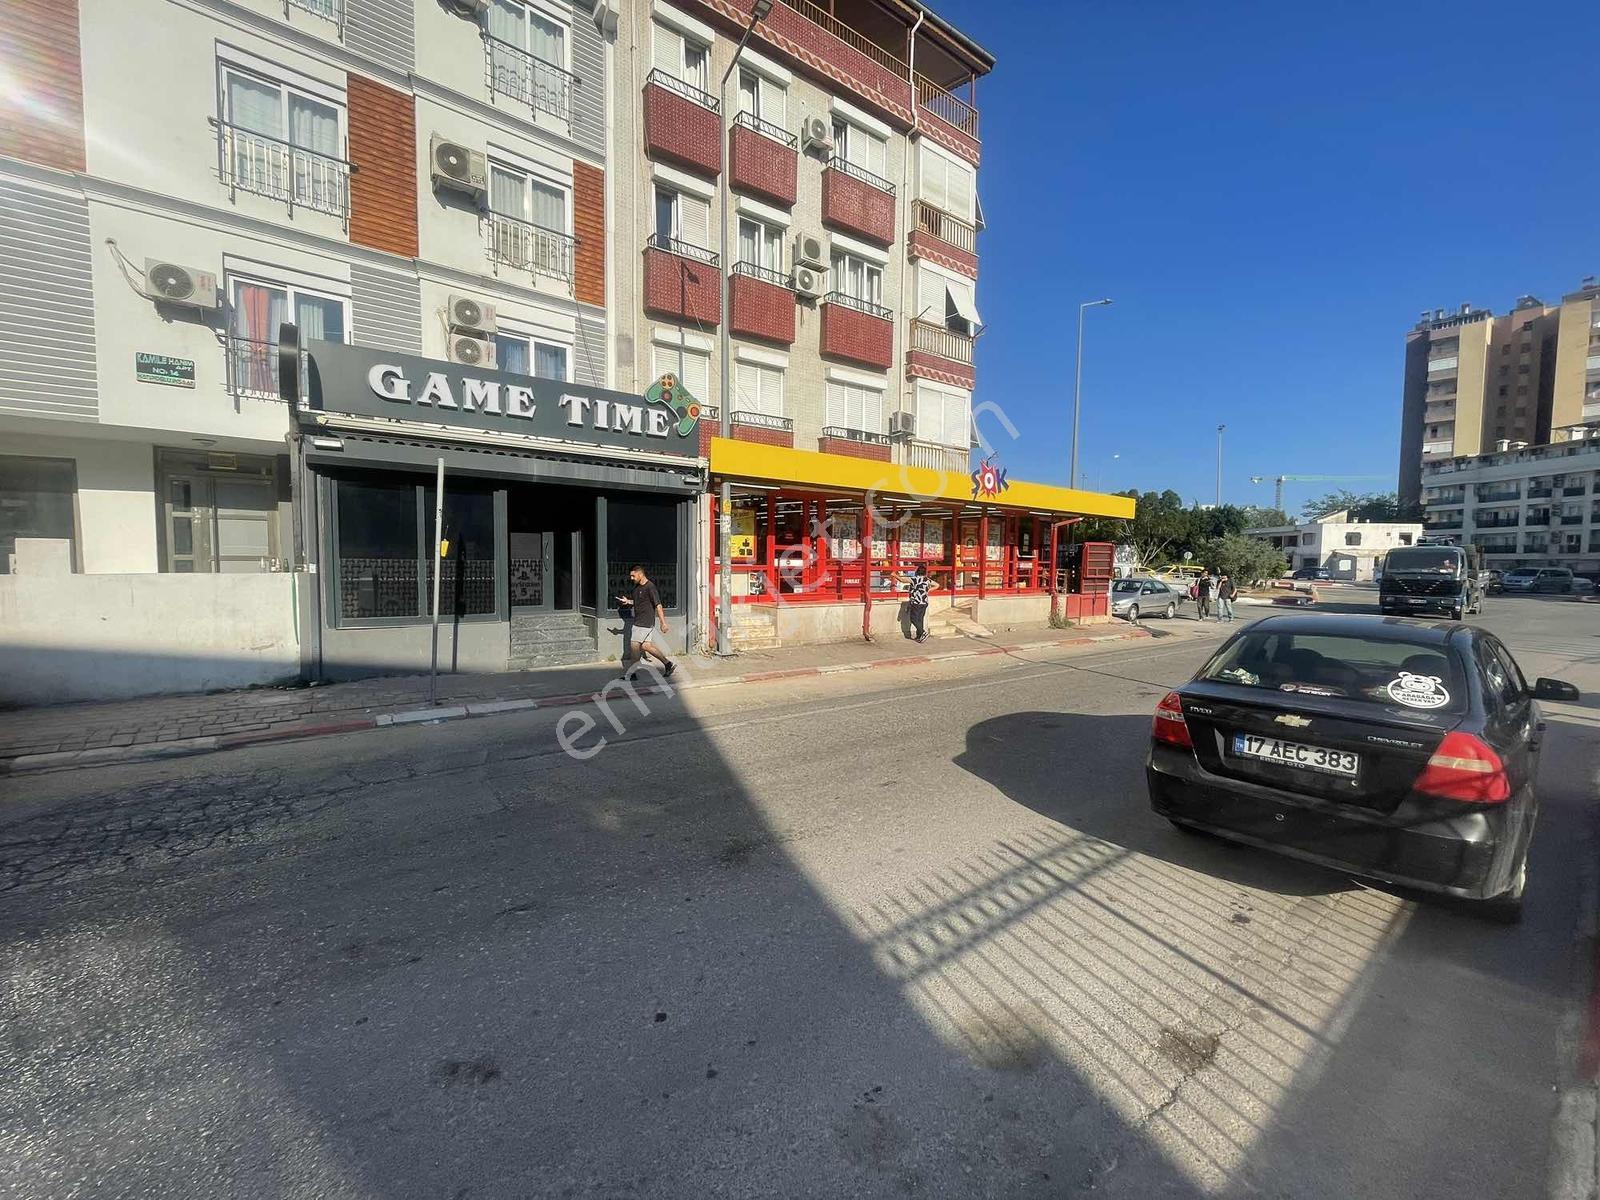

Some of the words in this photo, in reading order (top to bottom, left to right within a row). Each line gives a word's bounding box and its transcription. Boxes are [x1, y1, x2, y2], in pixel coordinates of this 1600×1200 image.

[367, 363, 537, 420] GAME
[558, 393, 670, 438] TIME
[1245, 736, 1266, 754] 17
[1269, 741, 1308, 762] AEC
[1313, 749, 1356, 771] 383
[1286, 761, 1305, 769] OTO
